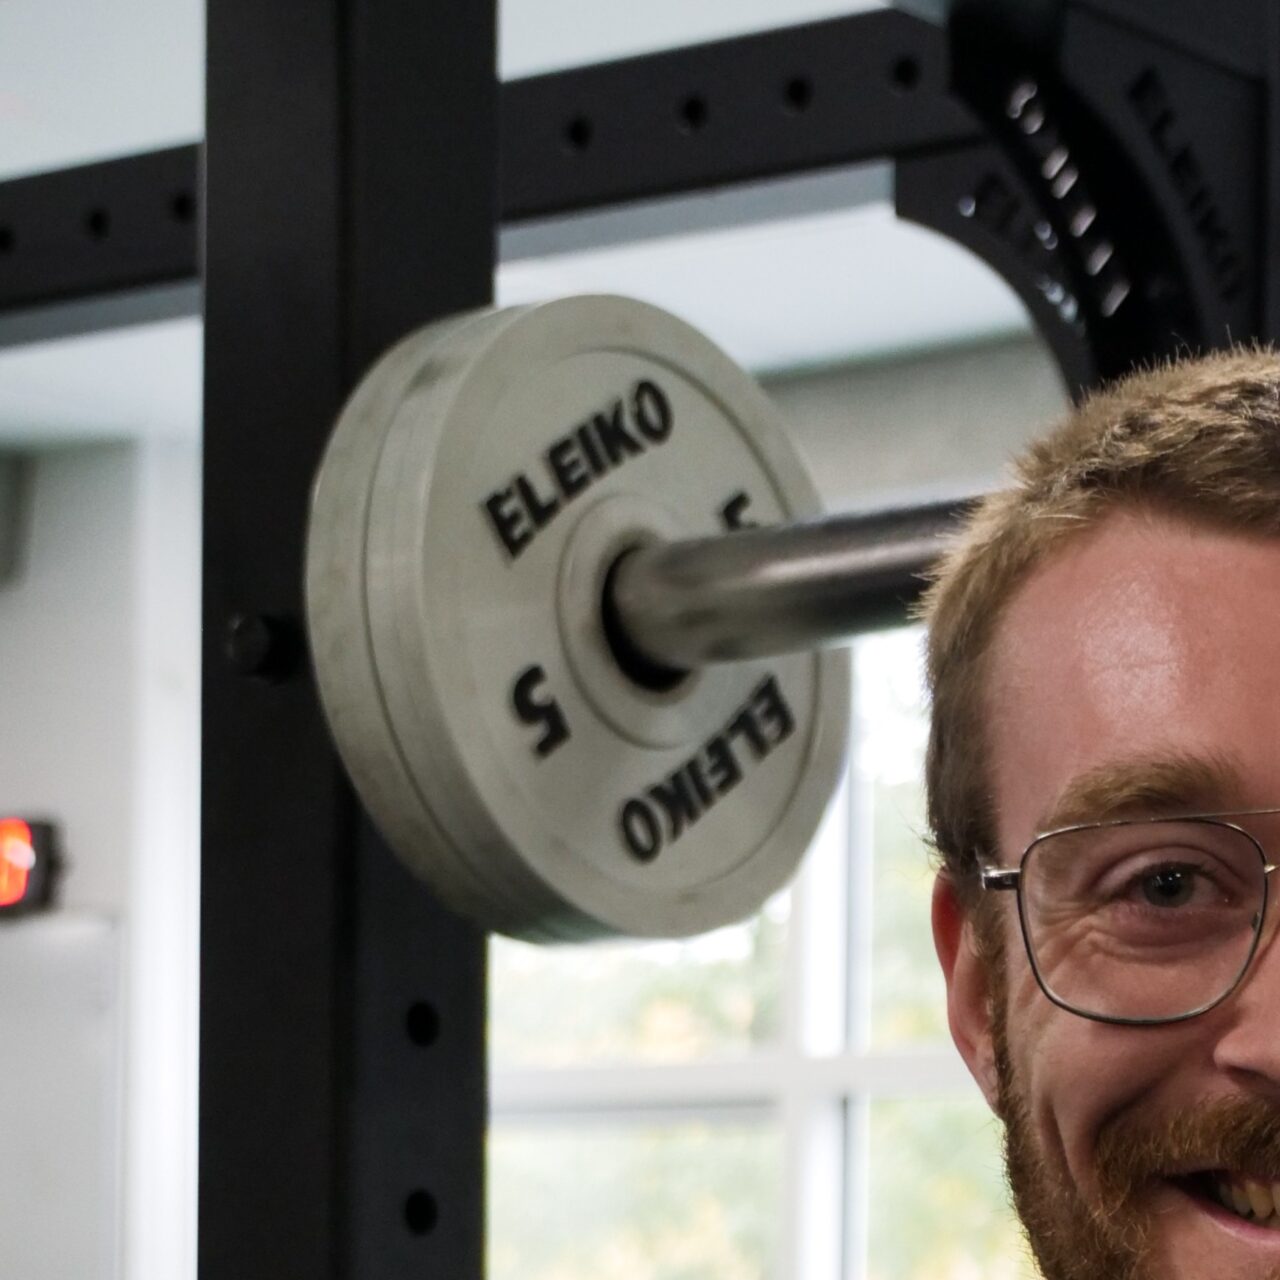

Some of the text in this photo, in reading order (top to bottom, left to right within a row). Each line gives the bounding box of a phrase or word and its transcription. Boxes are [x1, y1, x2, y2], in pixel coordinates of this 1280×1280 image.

[482, 378, 672, 560] ELEIKO
[511, 662, 572, 760] 5
[617, 674, 798, 863] ELEIKO
